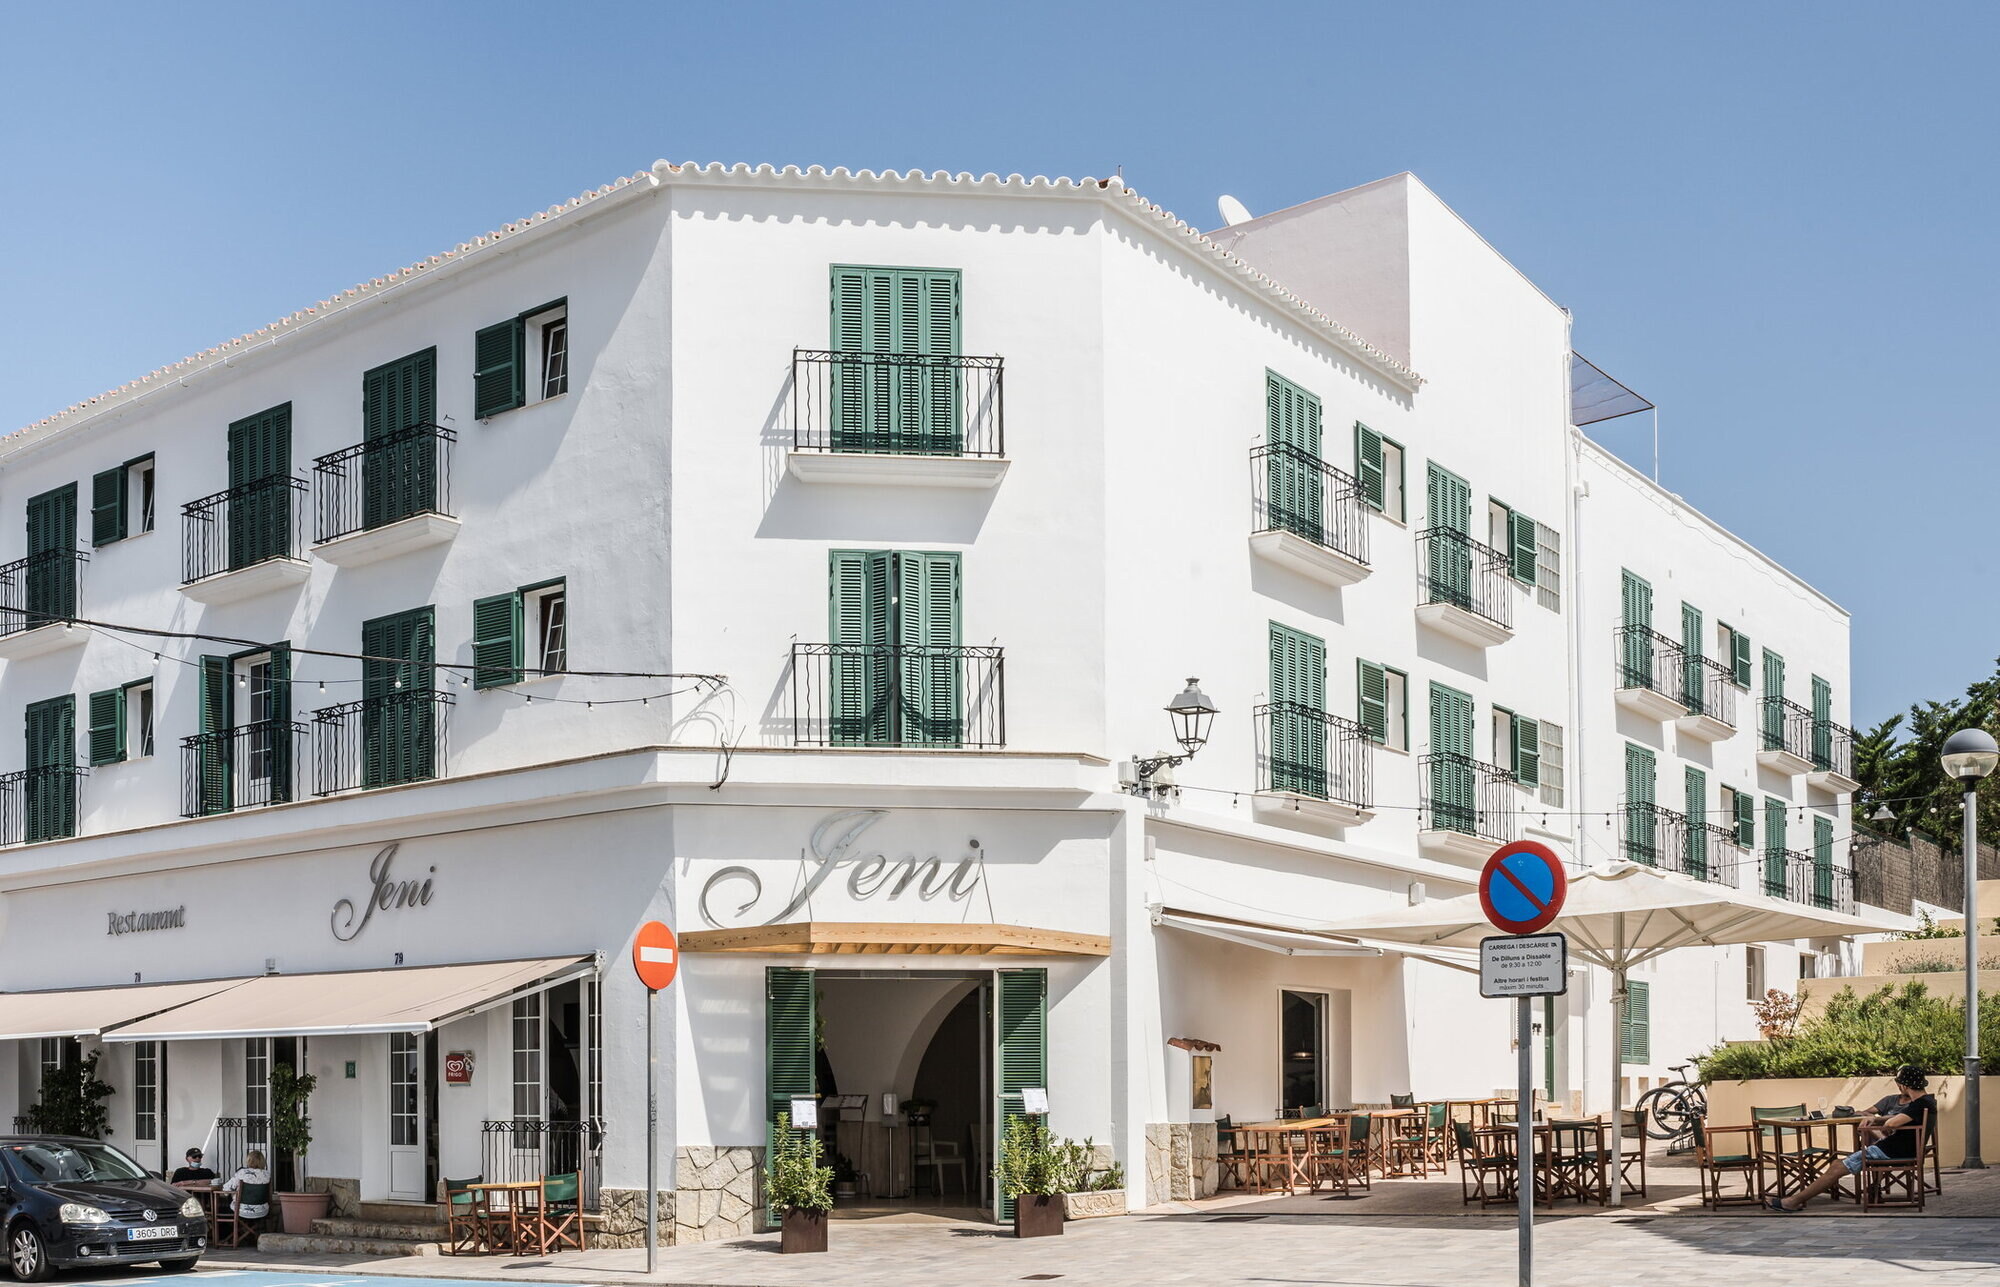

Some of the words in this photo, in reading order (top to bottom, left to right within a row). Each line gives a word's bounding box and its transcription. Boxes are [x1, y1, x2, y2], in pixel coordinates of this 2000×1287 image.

[702, 809, 981, 928] Jeni
[330, 842, 436, 942] Jeni
[106, 904, 186, 936] Restaurant
[1488, 943, 1515, 951] CARREGA
[395, 952, 404, 965] 79
[135, 1228, 157, 1239] 3605
